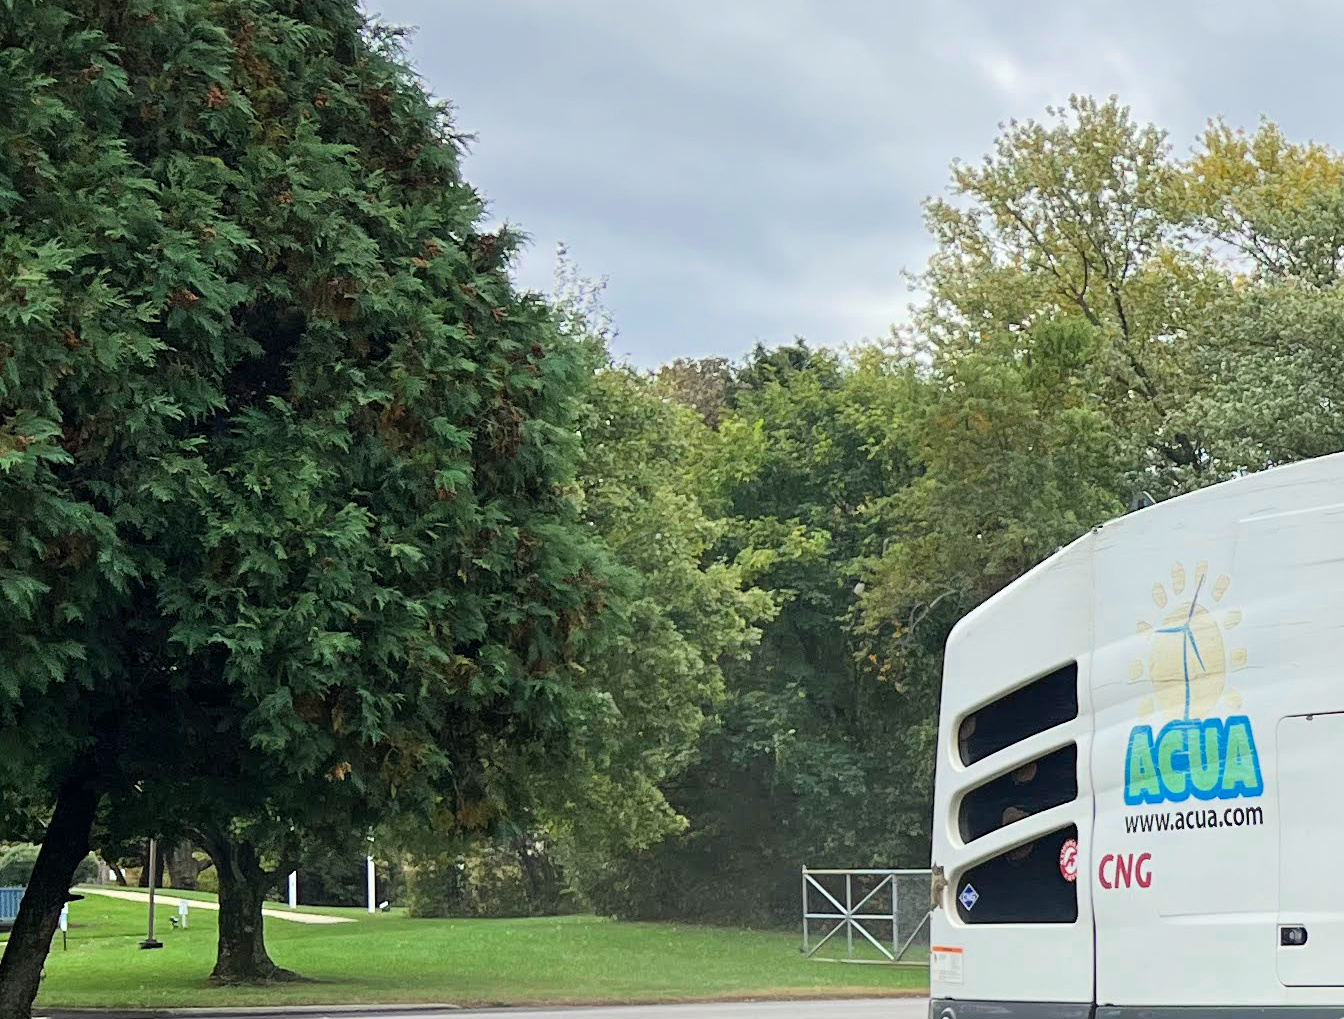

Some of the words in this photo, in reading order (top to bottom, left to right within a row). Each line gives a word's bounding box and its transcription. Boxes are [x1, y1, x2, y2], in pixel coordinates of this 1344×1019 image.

[1124, 715, 1264, 806] ACUA
[1125, 806, 1263, 833] www.acua.com
[1098, 853, 1152, 889] CNG
